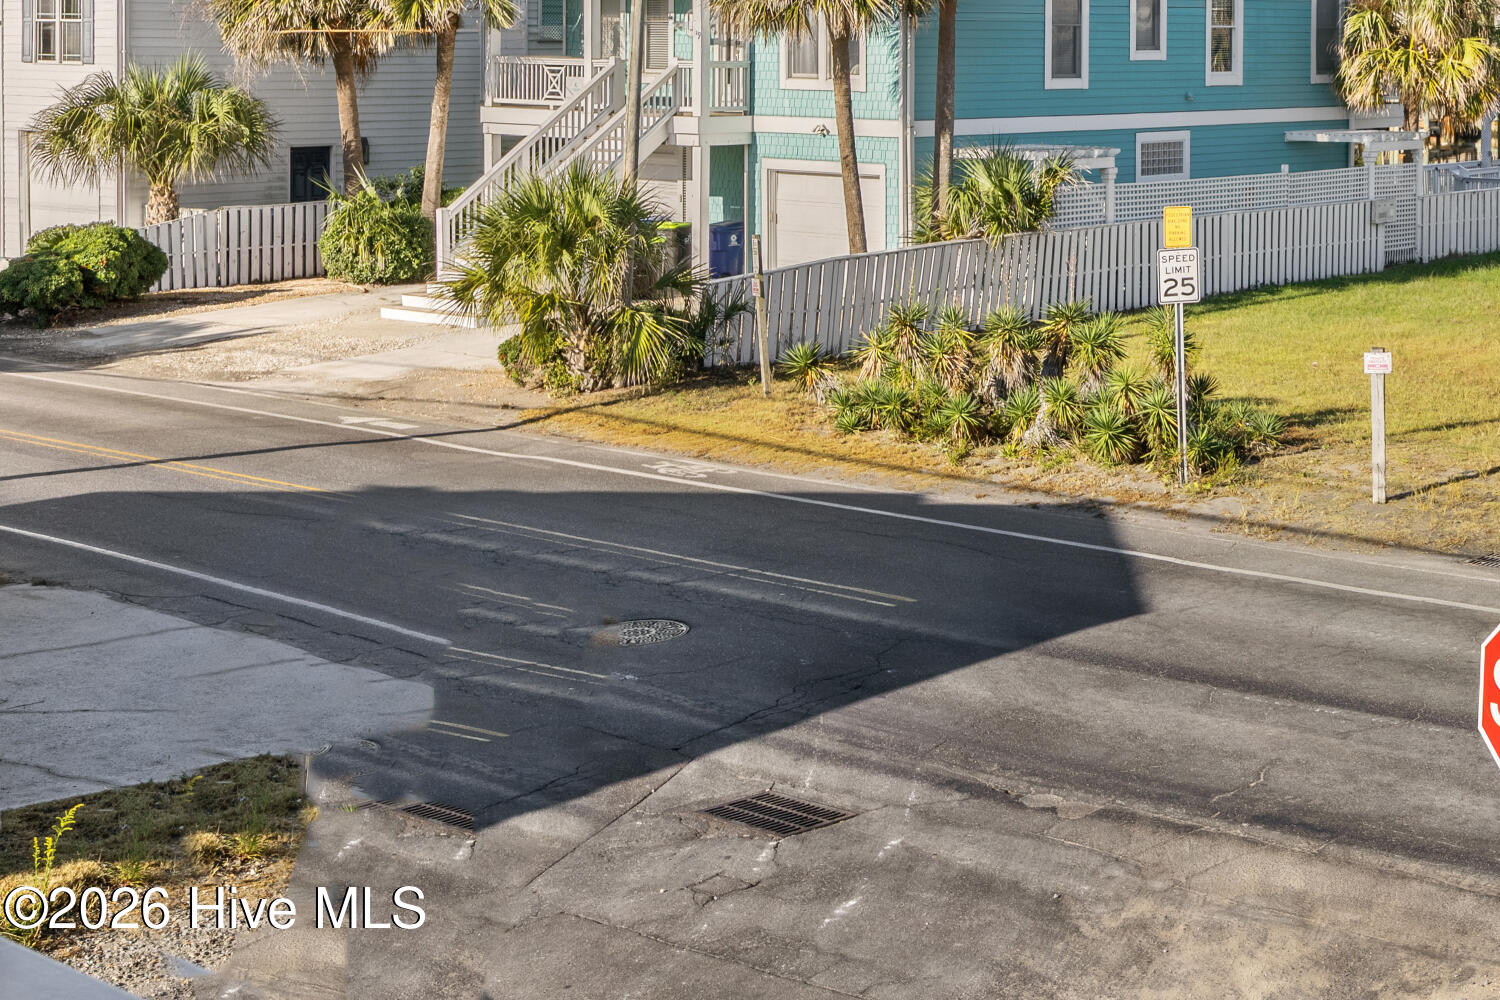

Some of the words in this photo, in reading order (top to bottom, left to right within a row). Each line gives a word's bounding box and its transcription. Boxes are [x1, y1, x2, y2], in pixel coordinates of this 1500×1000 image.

[1161, 254, 1195, 263] SPEED
[1165, 265, 1191, 275] LIMIT
[1163, 277, 1195, 297] 25
